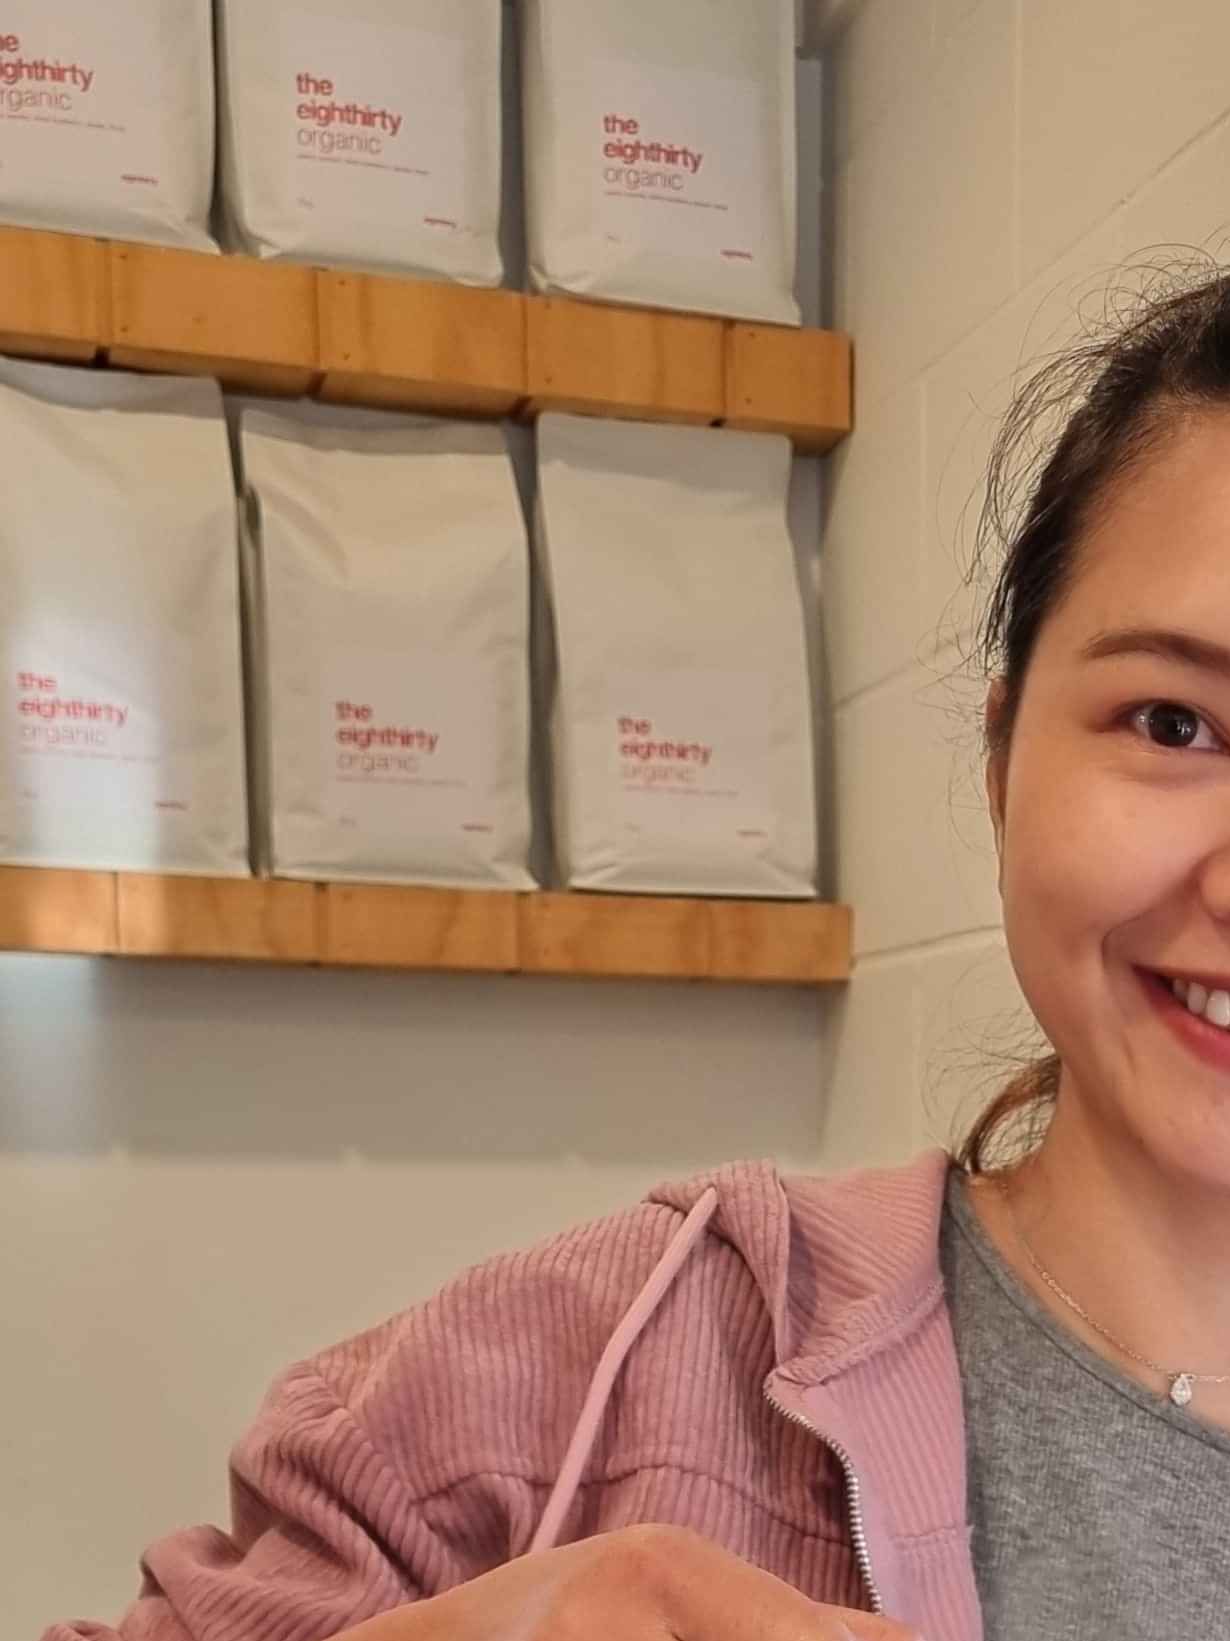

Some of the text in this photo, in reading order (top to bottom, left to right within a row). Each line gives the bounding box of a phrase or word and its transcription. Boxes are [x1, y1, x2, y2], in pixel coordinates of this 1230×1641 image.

[0, 56, 95, 93] ighthirty
[296, 72, 334, 96] the
[0, 87, 73, 112] rganic
[296, 99, 403, 137] eighthirty
[603, 115, 640, 134] the
[297, 127, 383, 155] organic
[603, 137, 704, 174] eighthirty
[603, 166, 685, 191] organic
[17, 671, 57, 692] the
[17, 696, 129, 728] eighthirty
[336, 700, 373, 722] the
[617, 715, 651, 736] the
[336, 725, 440, 756] eighthirty
[619, 741, 713, 767] eighthirty
